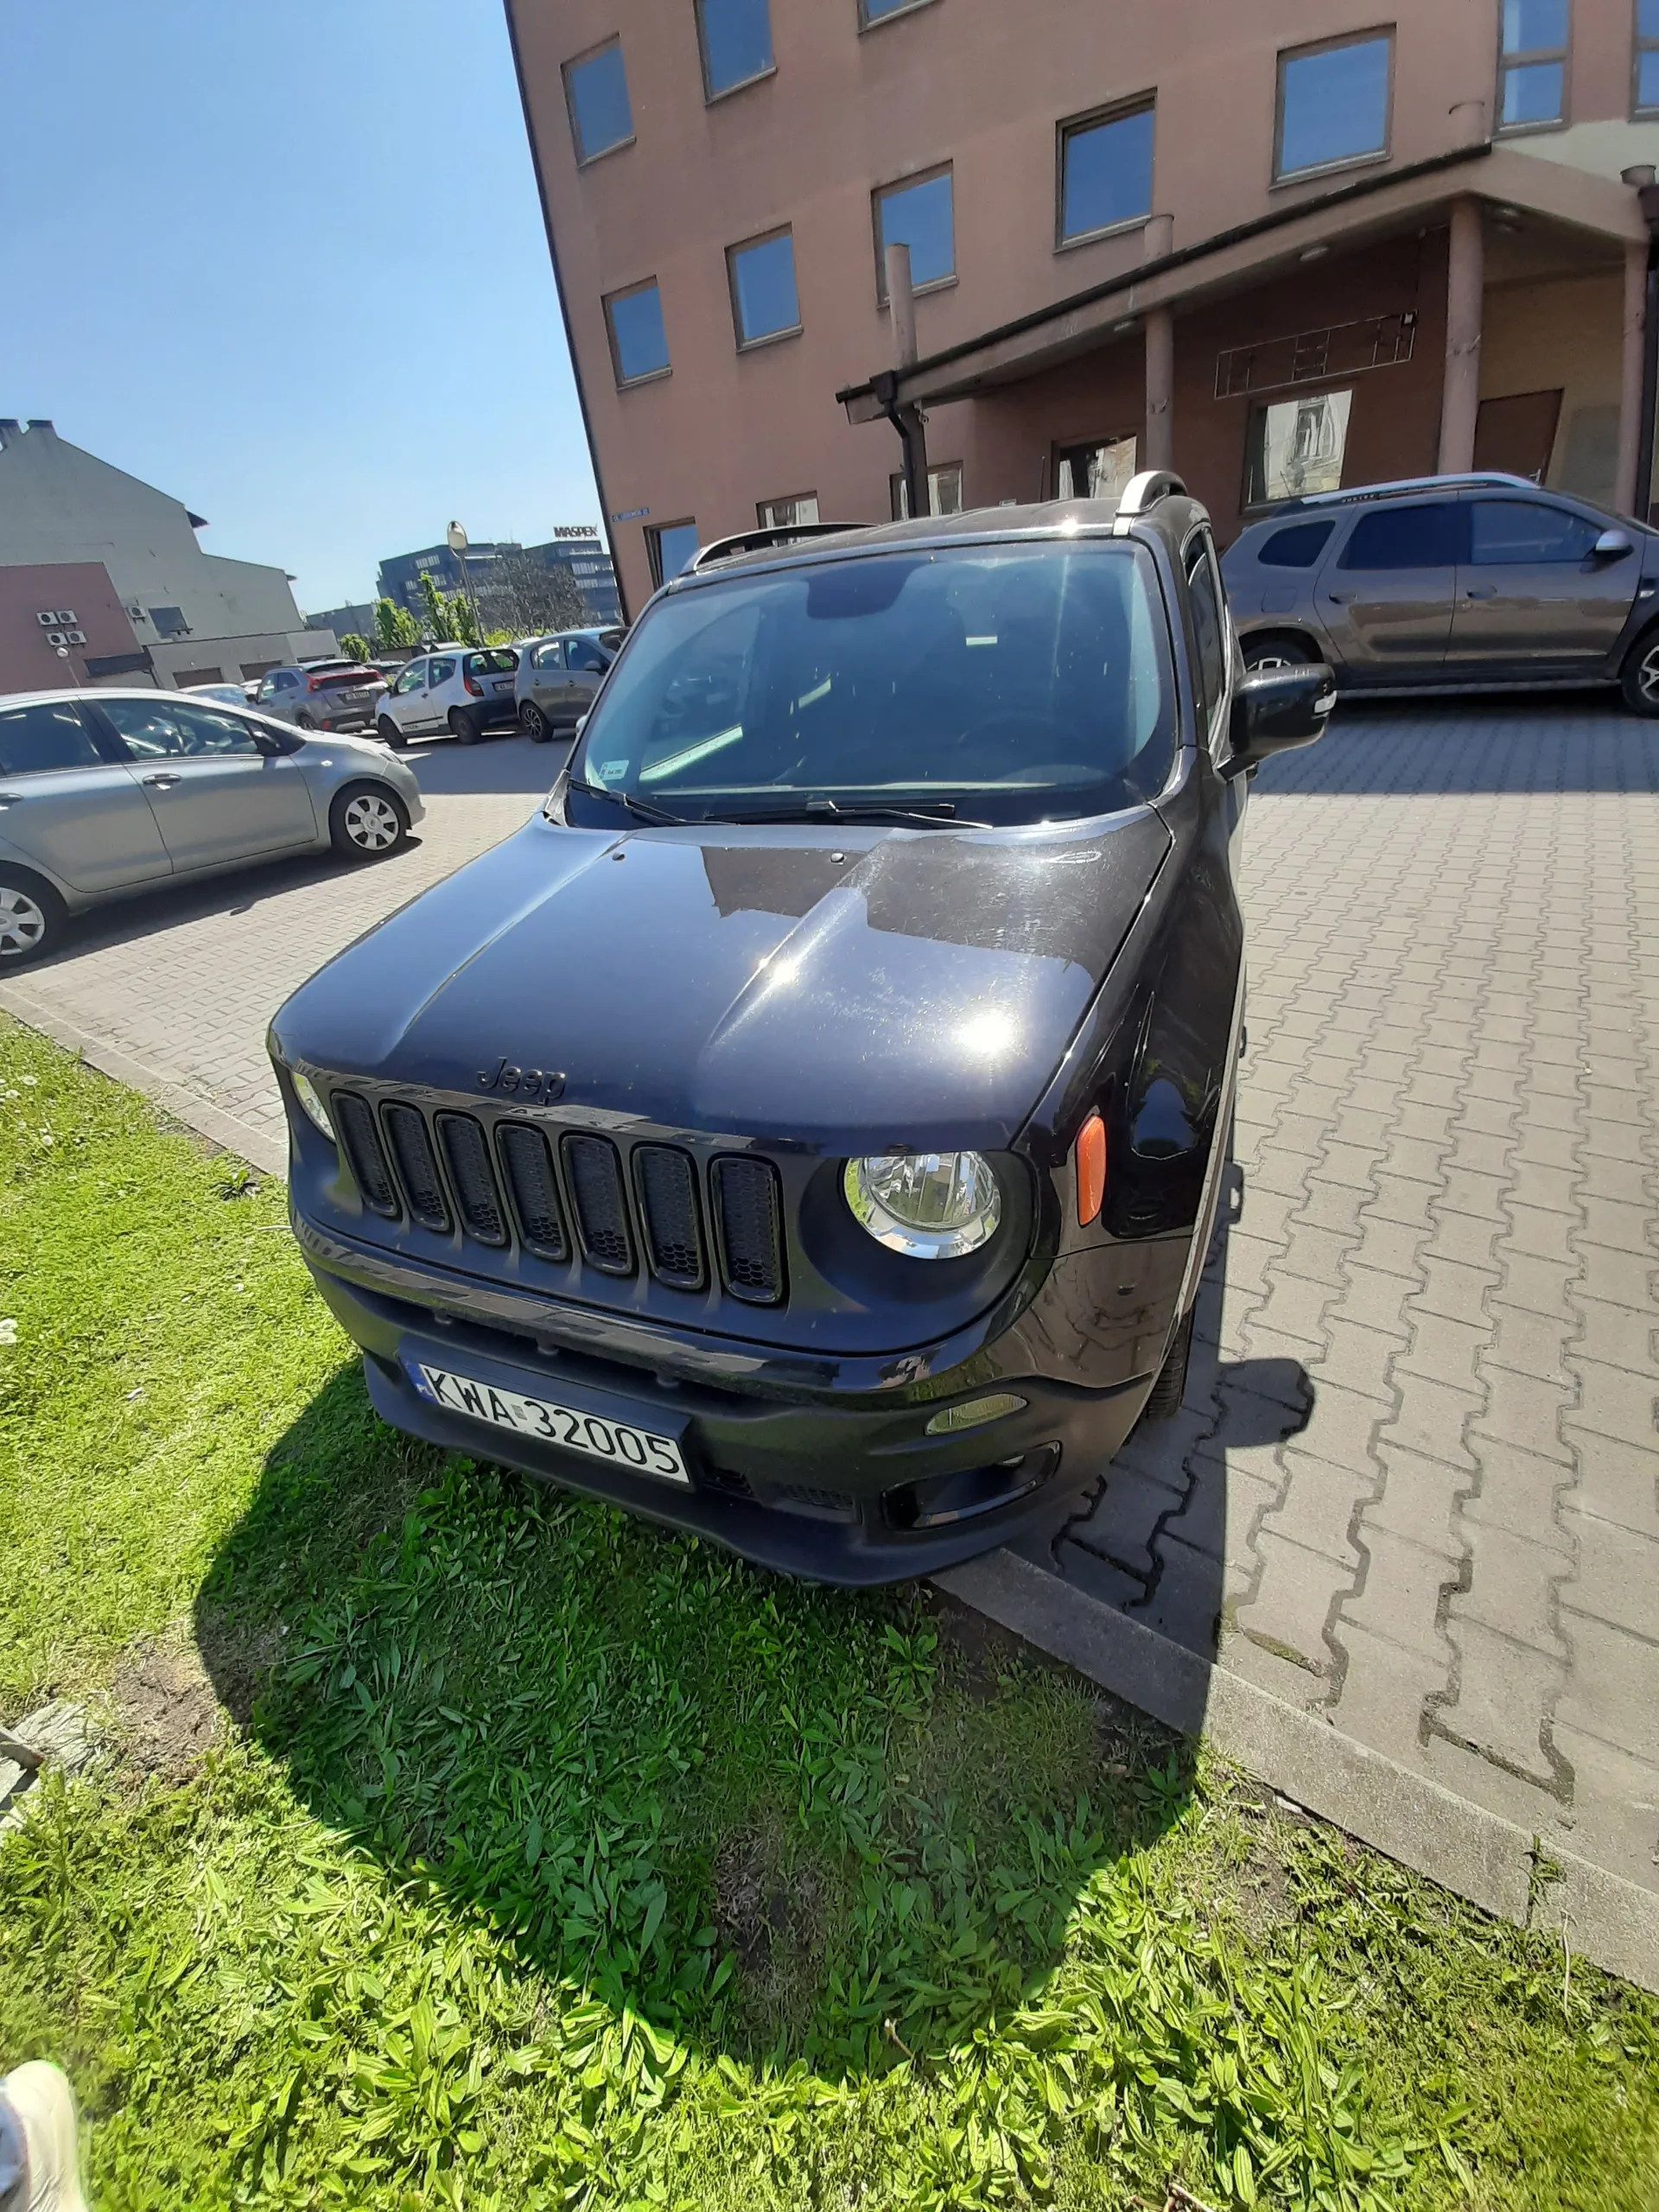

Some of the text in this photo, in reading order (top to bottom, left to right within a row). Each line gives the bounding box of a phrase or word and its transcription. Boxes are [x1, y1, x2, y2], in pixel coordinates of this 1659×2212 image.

[553, 523, 598, 537] MASPEX
[476, 1056, 567, 1106] Jeep
[416, 1382, 434, 1397] PL
[424, 1368, 681, 1474] KWA 32005
